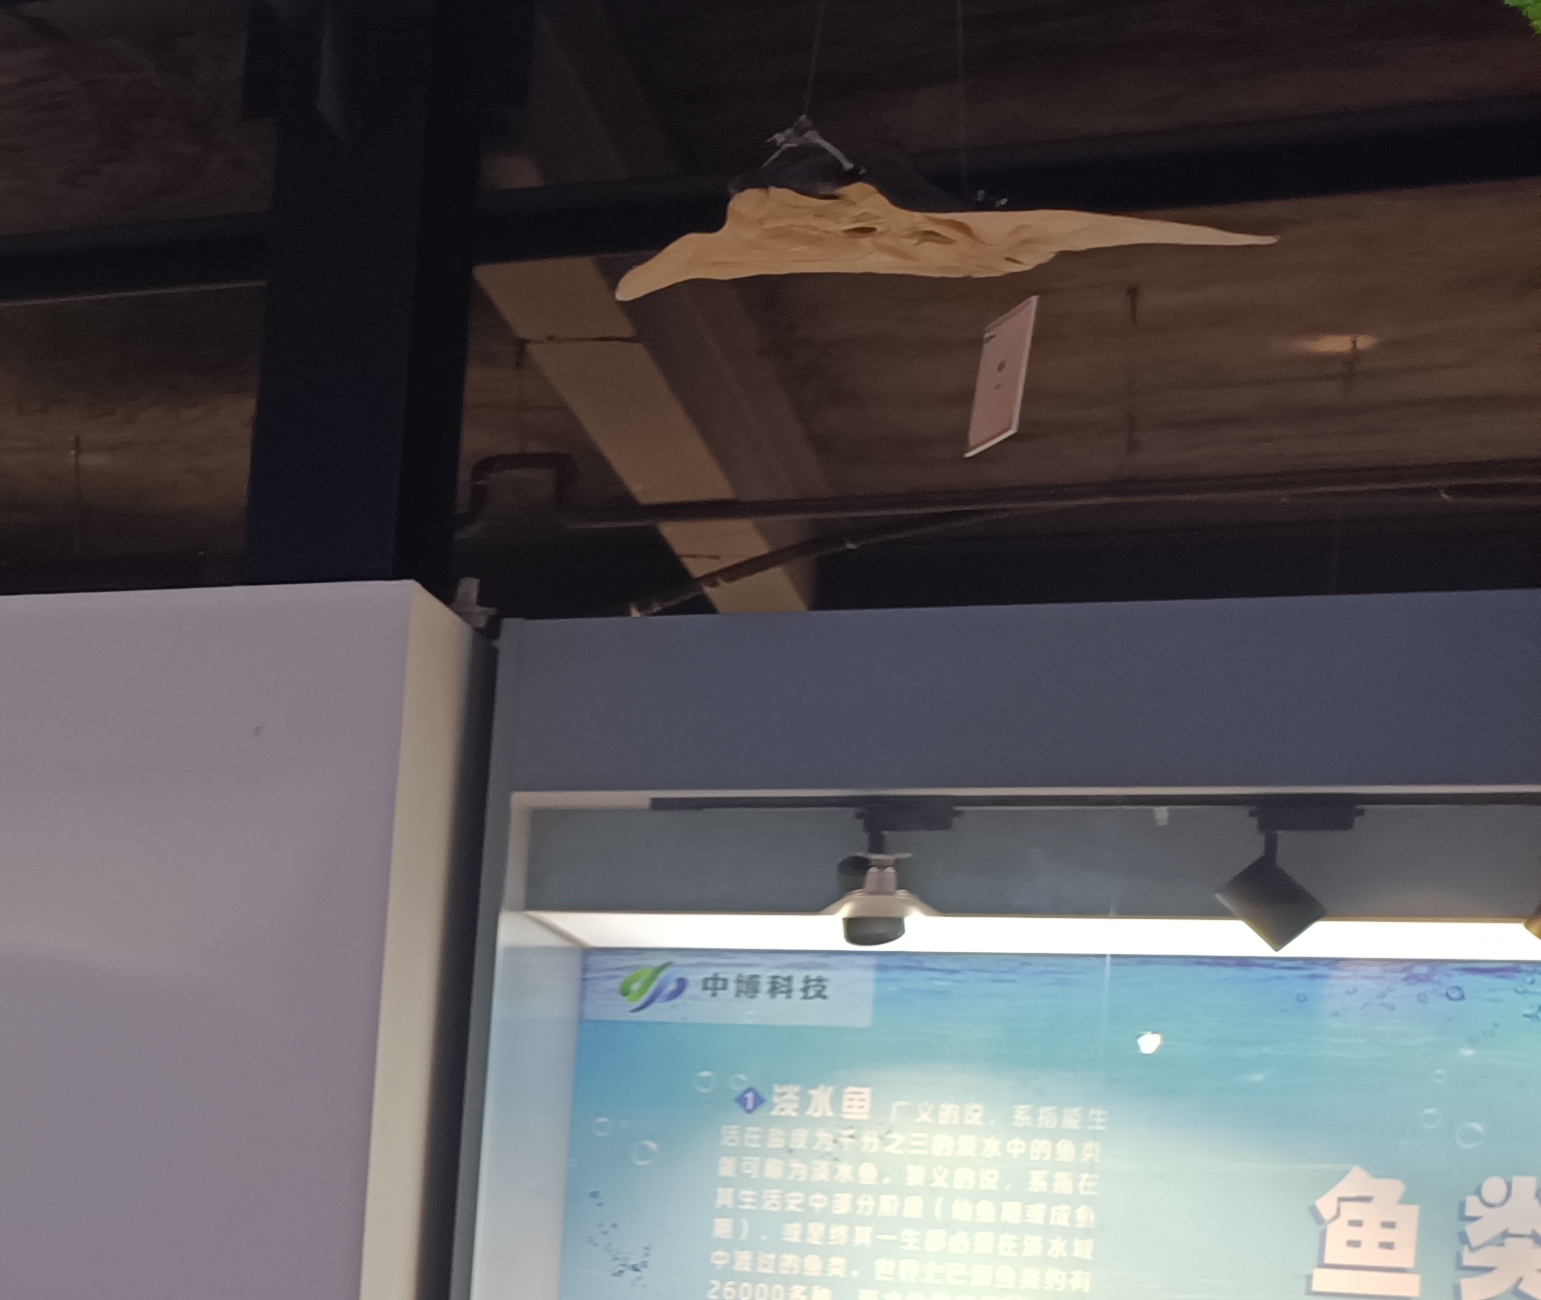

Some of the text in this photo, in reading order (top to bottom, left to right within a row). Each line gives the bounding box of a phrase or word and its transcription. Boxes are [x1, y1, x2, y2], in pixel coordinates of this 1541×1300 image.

[701, 973, 829, 1000] 中博科技
[770, 1083, 873, 1121] 淡水鱼
